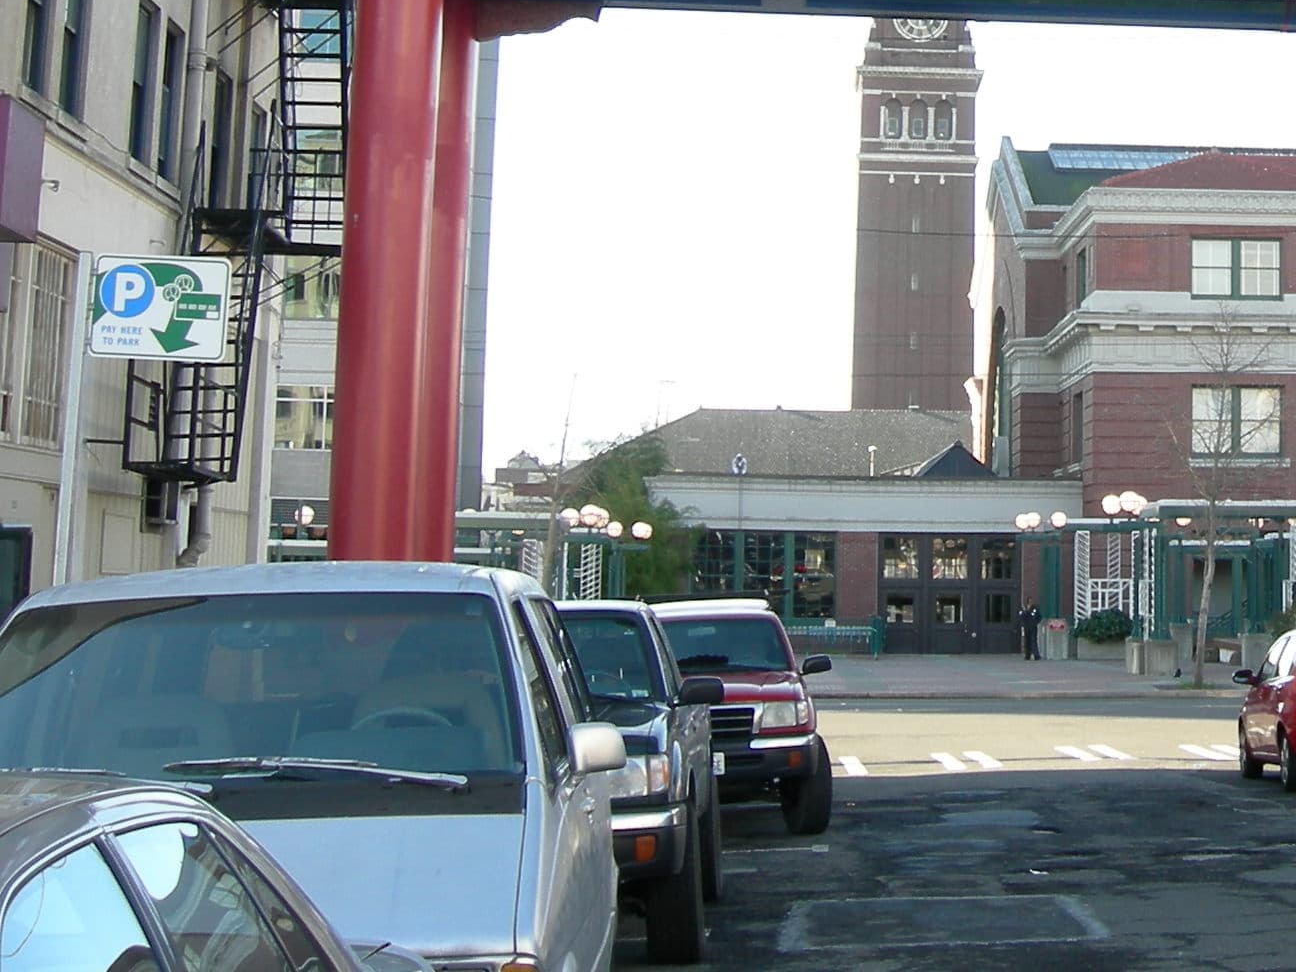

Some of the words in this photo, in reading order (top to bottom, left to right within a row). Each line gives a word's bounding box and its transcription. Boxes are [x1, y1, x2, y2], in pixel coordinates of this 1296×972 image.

[113, 272, 146, 312] P
[101, 325, 115, 333] PAY
[121, 326, 143, 334] HERE
[104, 337, 113, 345] TO
[117, 337, 140, 346] PARK
